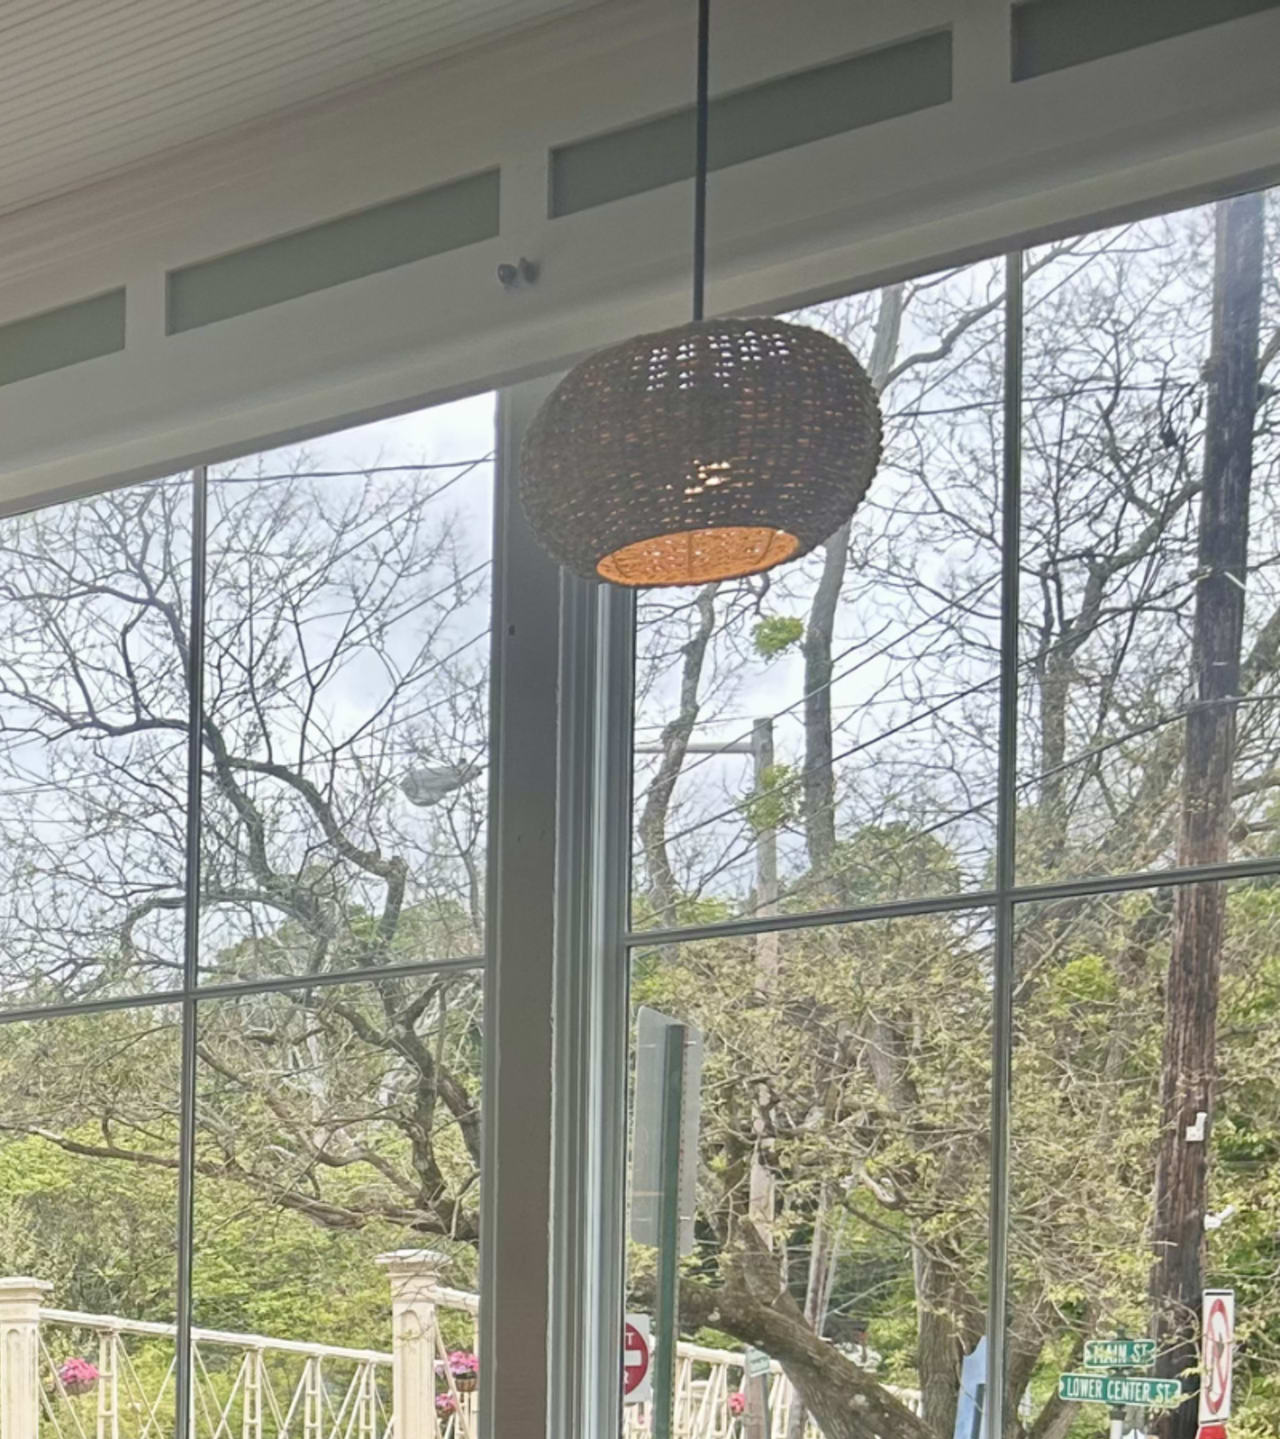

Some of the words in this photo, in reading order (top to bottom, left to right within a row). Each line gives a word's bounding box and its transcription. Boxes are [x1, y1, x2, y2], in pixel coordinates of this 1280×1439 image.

[1094, 1344, 1127, 1364] MAIN
[1067, 1378, 1102, 1398] LOWER
[1107, 1380, 1150, 1401] CENTER
